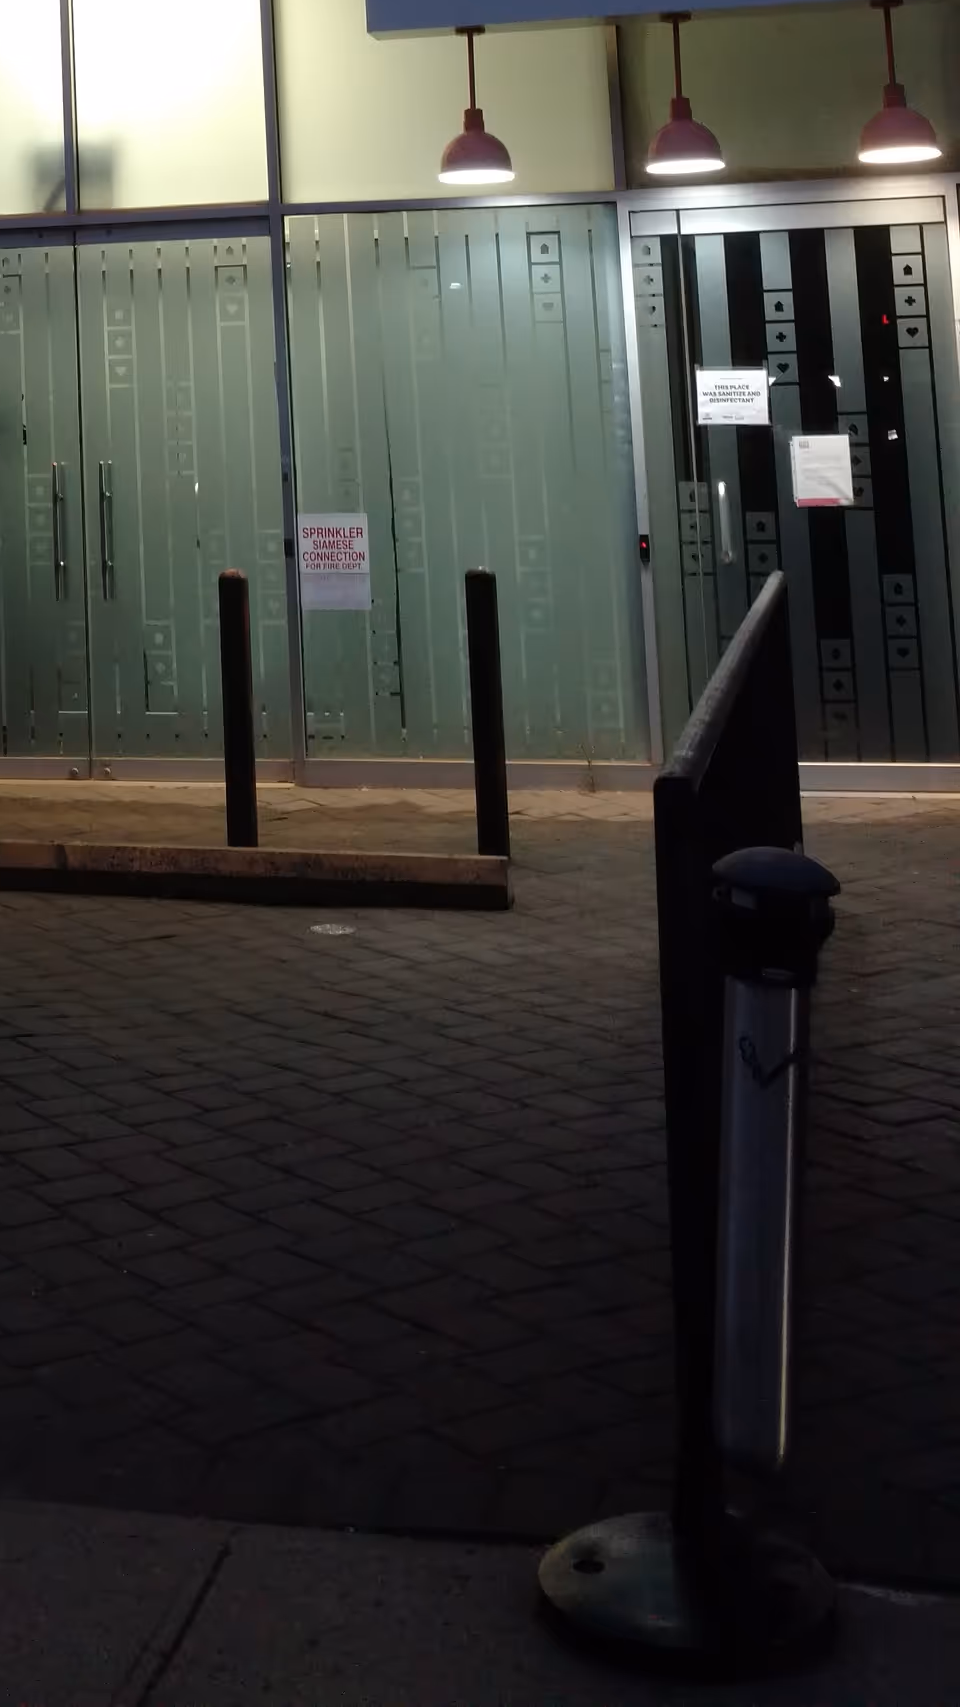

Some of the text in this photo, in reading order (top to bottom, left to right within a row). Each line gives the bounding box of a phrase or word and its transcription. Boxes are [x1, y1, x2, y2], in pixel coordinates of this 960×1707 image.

[302, 527, 364, 539] SPRINKLER
[313, 539, 354, 551] SIAMESE
[302, 551, 366, 562] CONNECTION
[305, 562, 320, 571] FOR
[322, 562, 341, 571] FIRE
